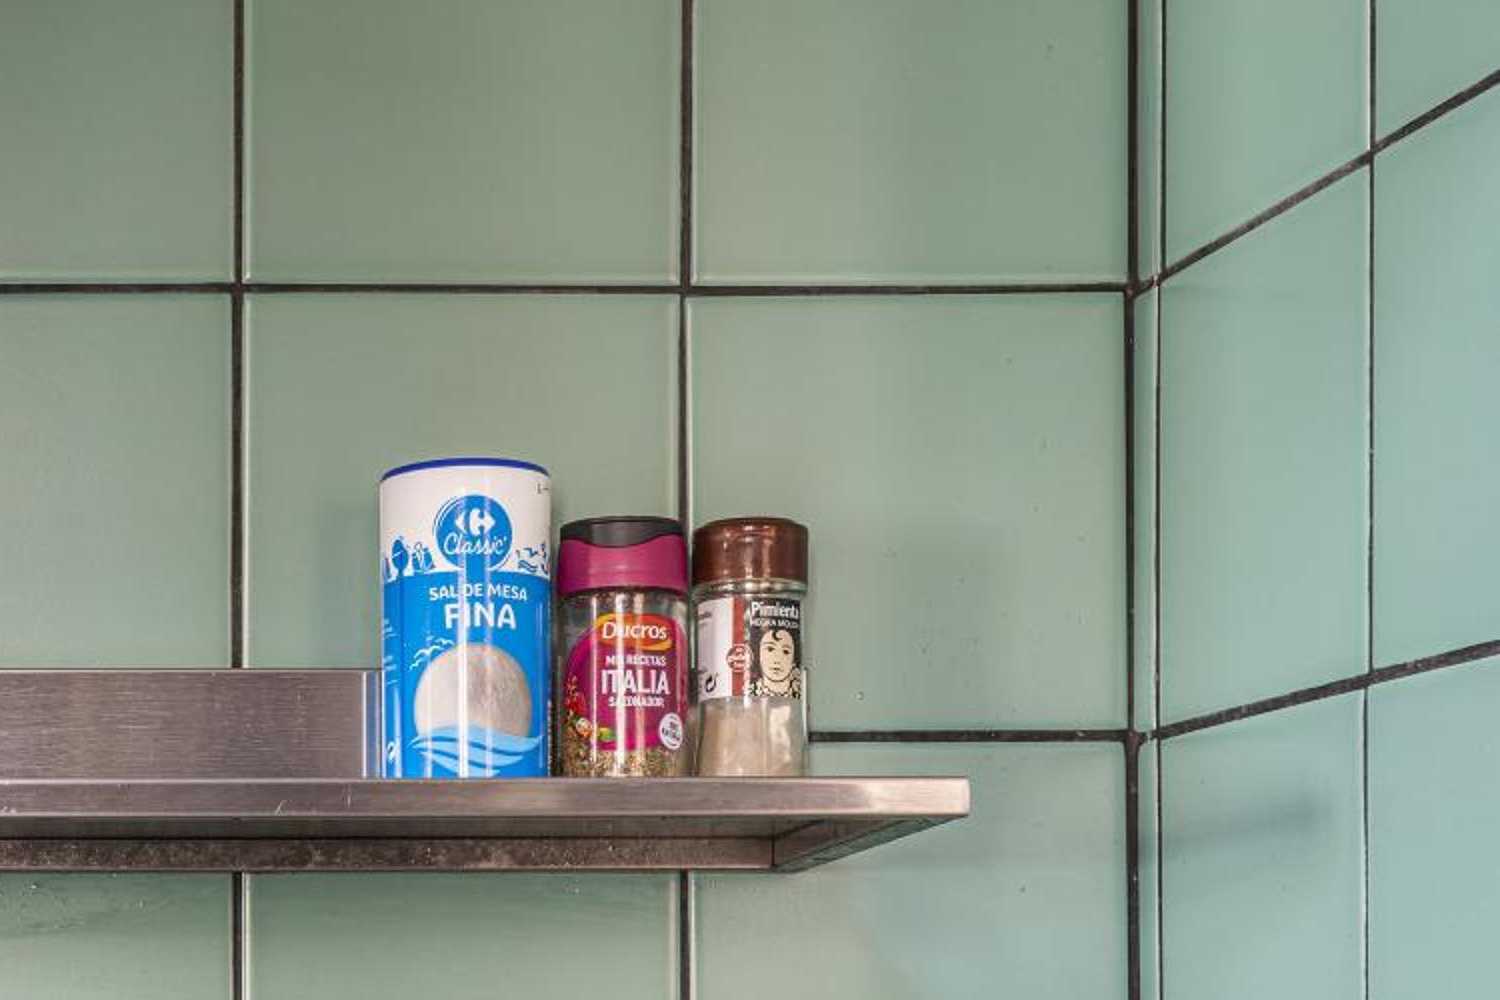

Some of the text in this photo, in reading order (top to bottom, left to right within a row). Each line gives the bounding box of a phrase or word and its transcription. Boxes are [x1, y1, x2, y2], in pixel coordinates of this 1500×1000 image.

[429, 583, 528, 601] SAL DE MESA
[444, 602, 517, 630] FINA
[601, 621, 668, 640] Ducros
[601, 669, 671, 695] ITALIA
